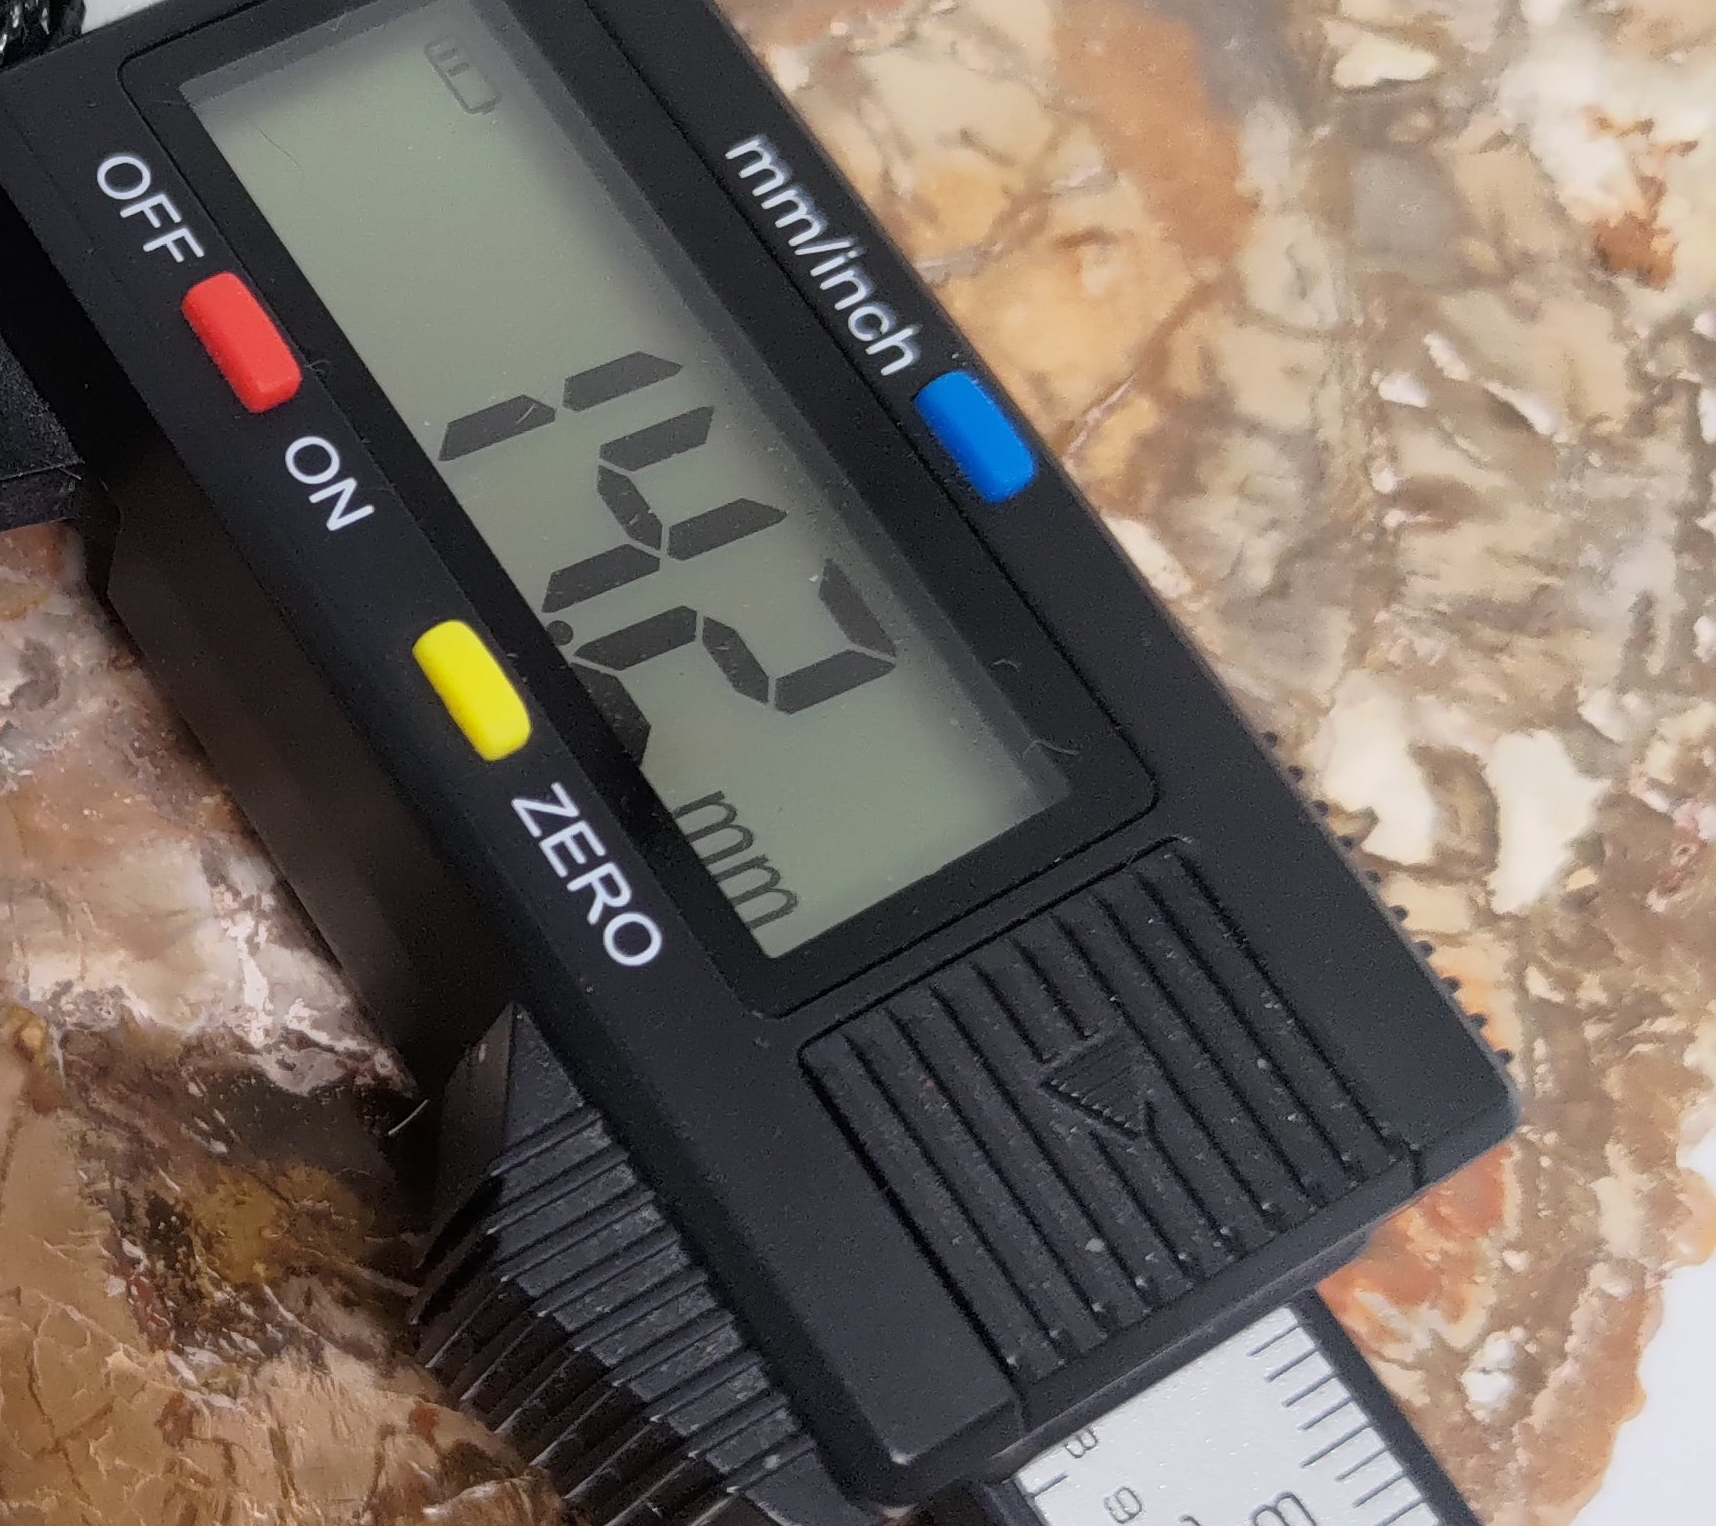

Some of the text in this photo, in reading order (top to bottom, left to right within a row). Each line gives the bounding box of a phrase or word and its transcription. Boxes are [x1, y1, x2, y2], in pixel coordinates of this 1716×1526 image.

[96, 155, 205, 263] OFF
[724, 134, 922, 376] mm/inch
[285, 436, 375, 532] ON
[437, 351, 896, 928] 14.2 mm
[511, 781, 662, 967] ZERO
